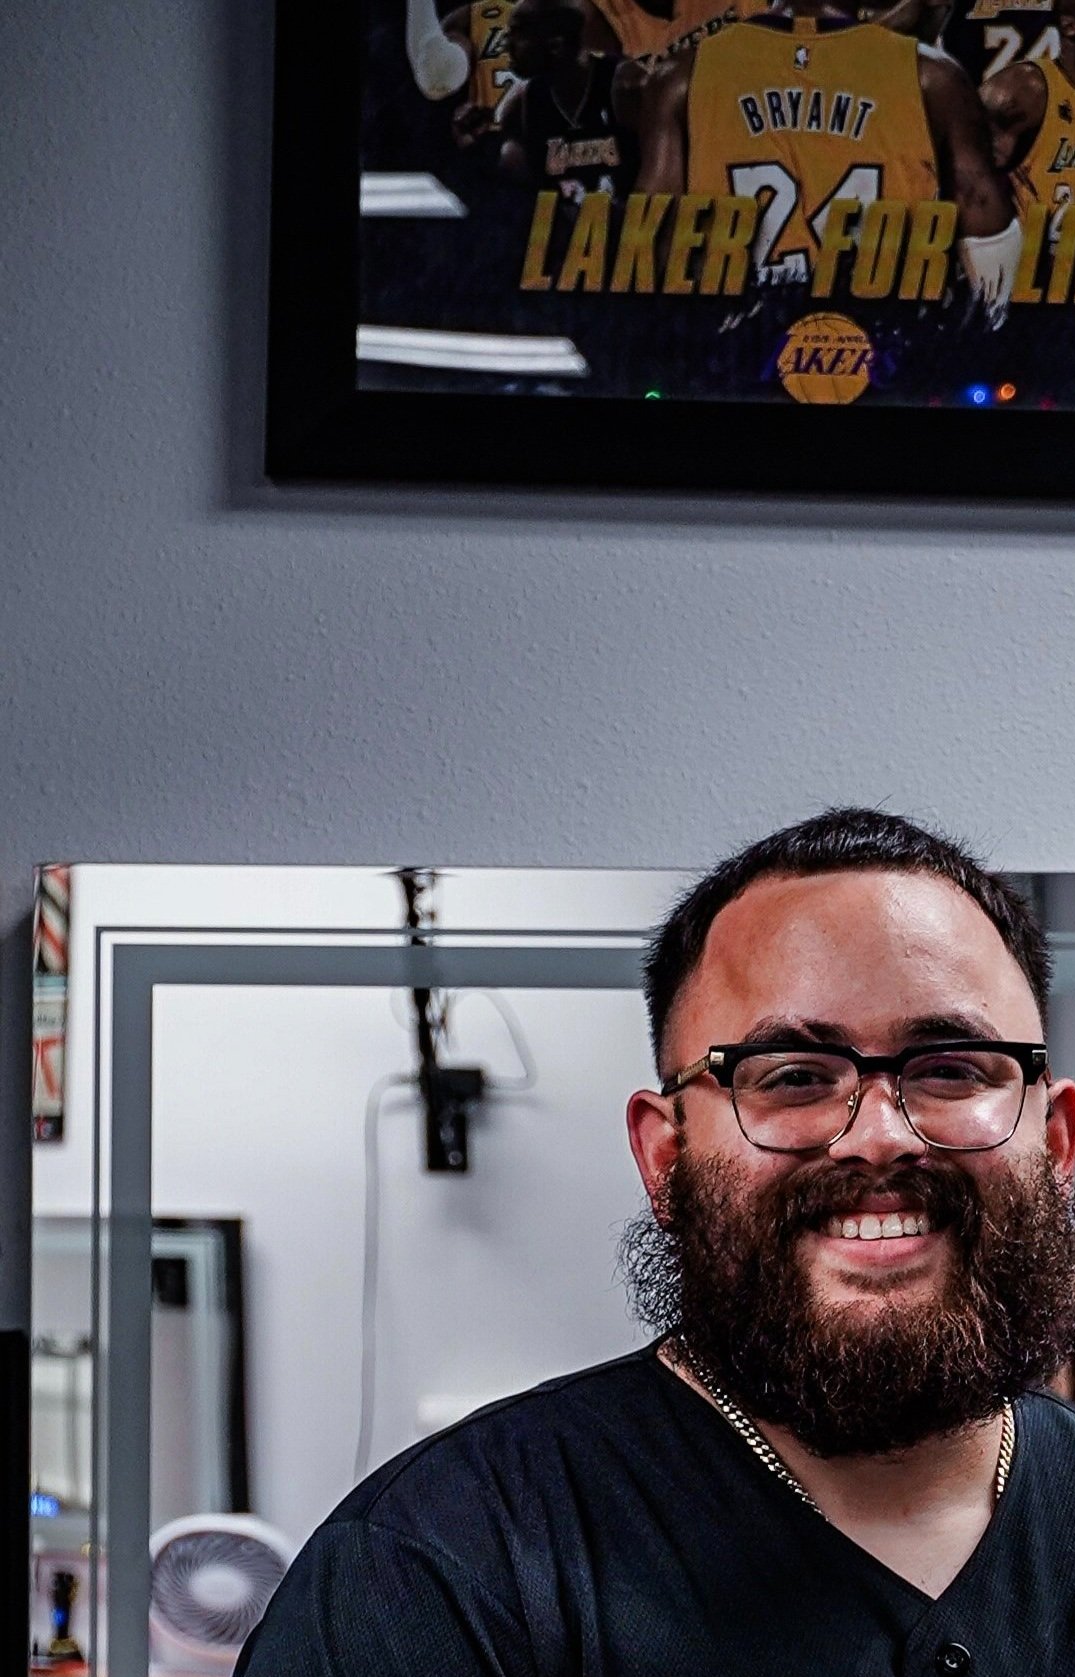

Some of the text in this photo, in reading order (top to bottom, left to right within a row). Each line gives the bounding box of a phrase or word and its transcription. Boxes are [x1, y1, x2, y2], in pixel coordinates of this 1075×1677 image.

[738, 88, 876, 140] BRYANT
[519, 190, 756, 296] LAKER
[810, 197, 957, 301] FOR
